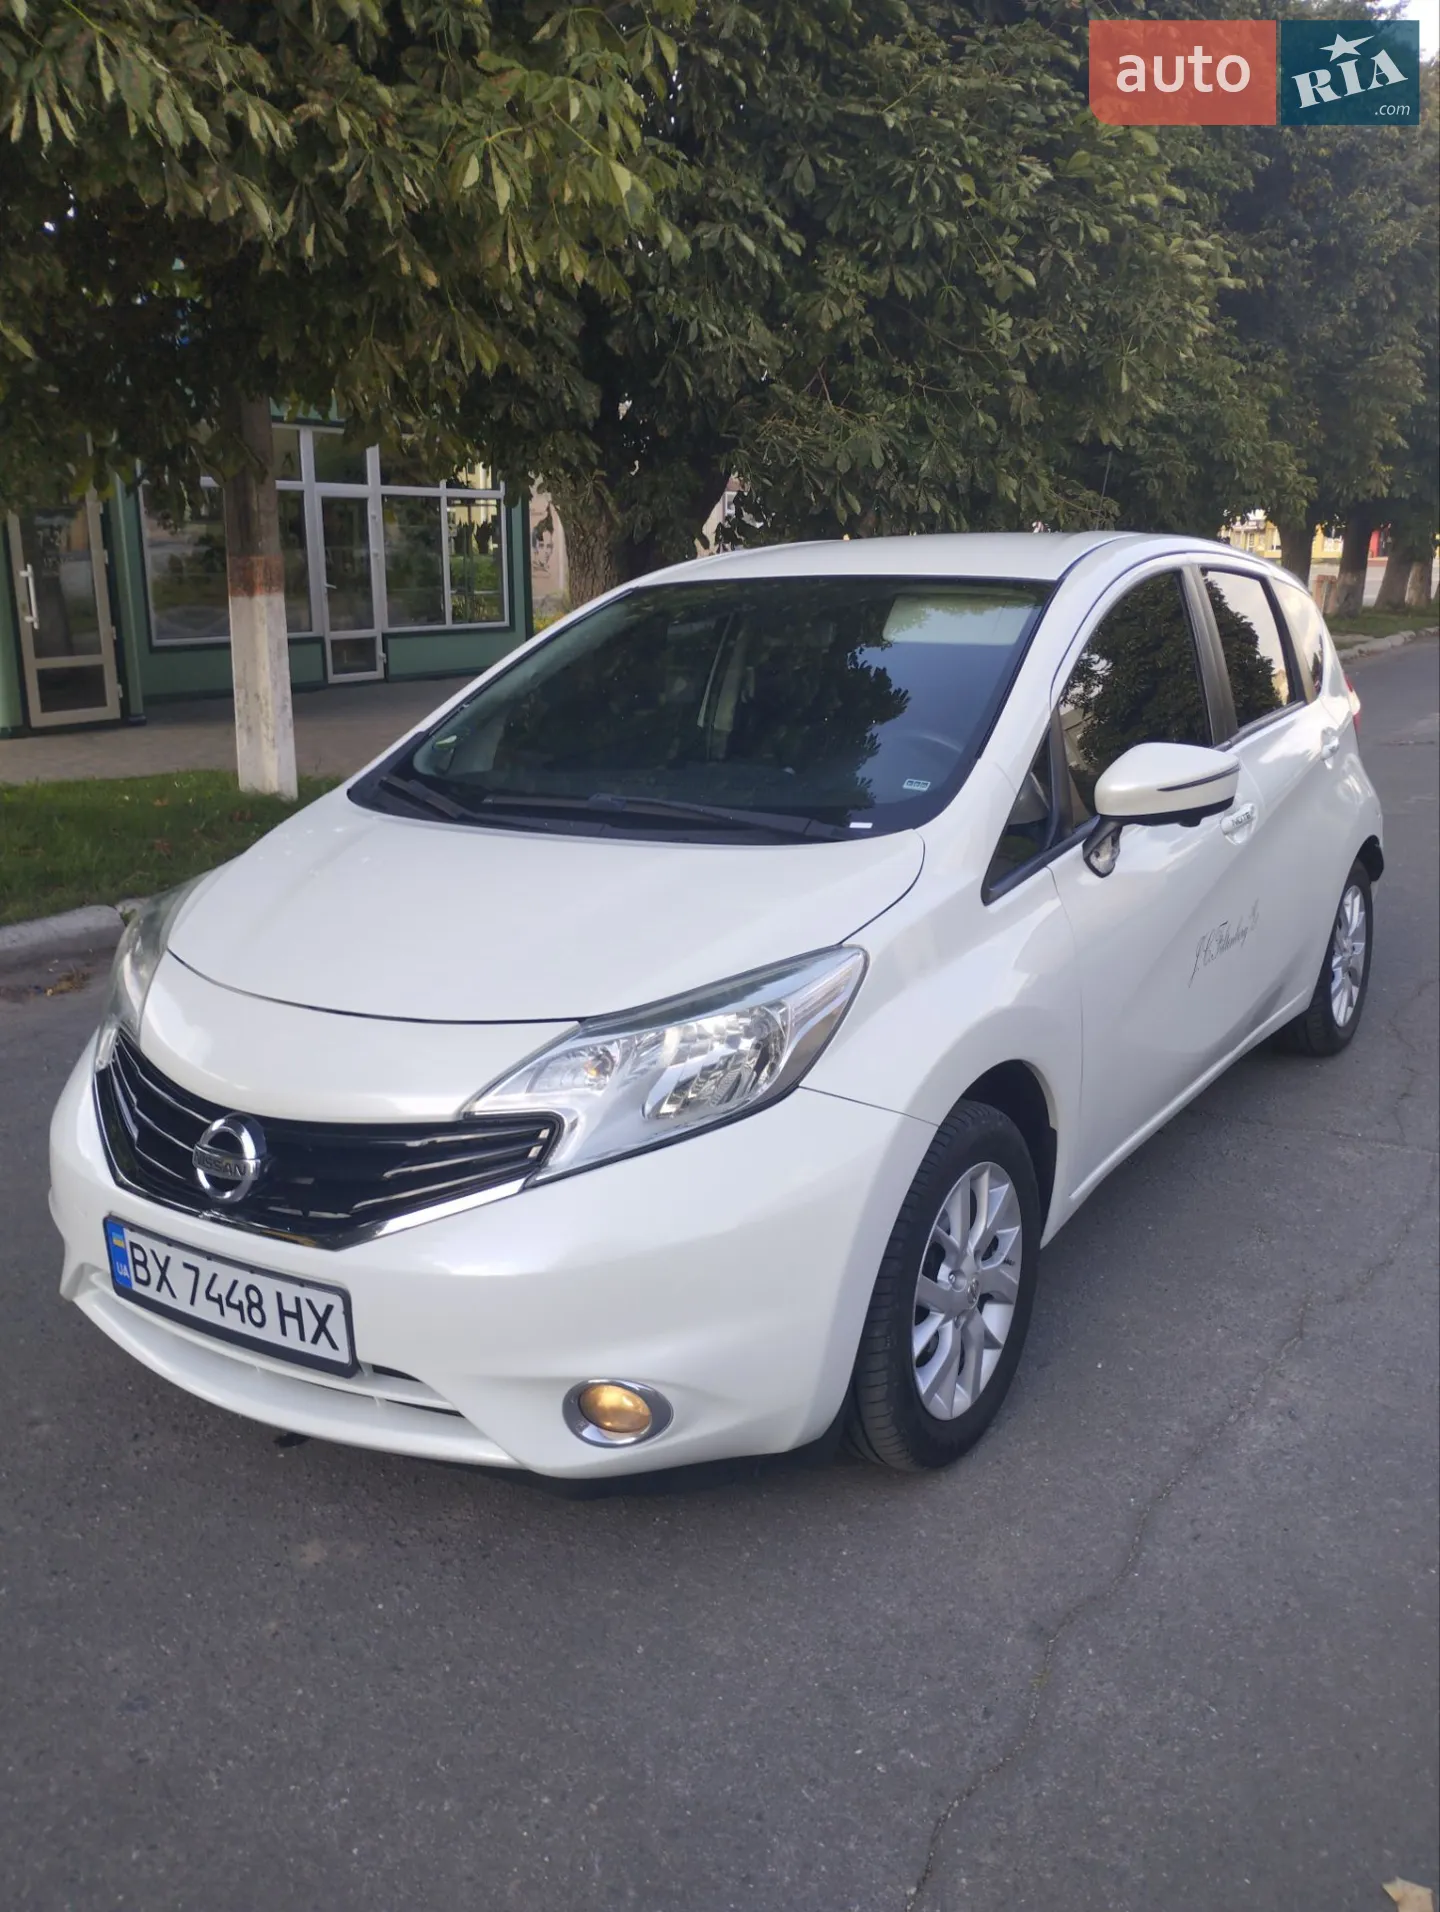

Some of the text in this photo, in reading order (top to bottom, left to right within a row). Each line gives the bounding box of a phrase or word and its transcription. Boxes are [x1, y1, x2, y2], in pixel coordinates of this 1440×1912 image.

[195, 1150, 246, 1177] NISSAN
[116, 1261, 130, 1279] UA
[129, 1240, 340, 1351] BX 7448 HX
